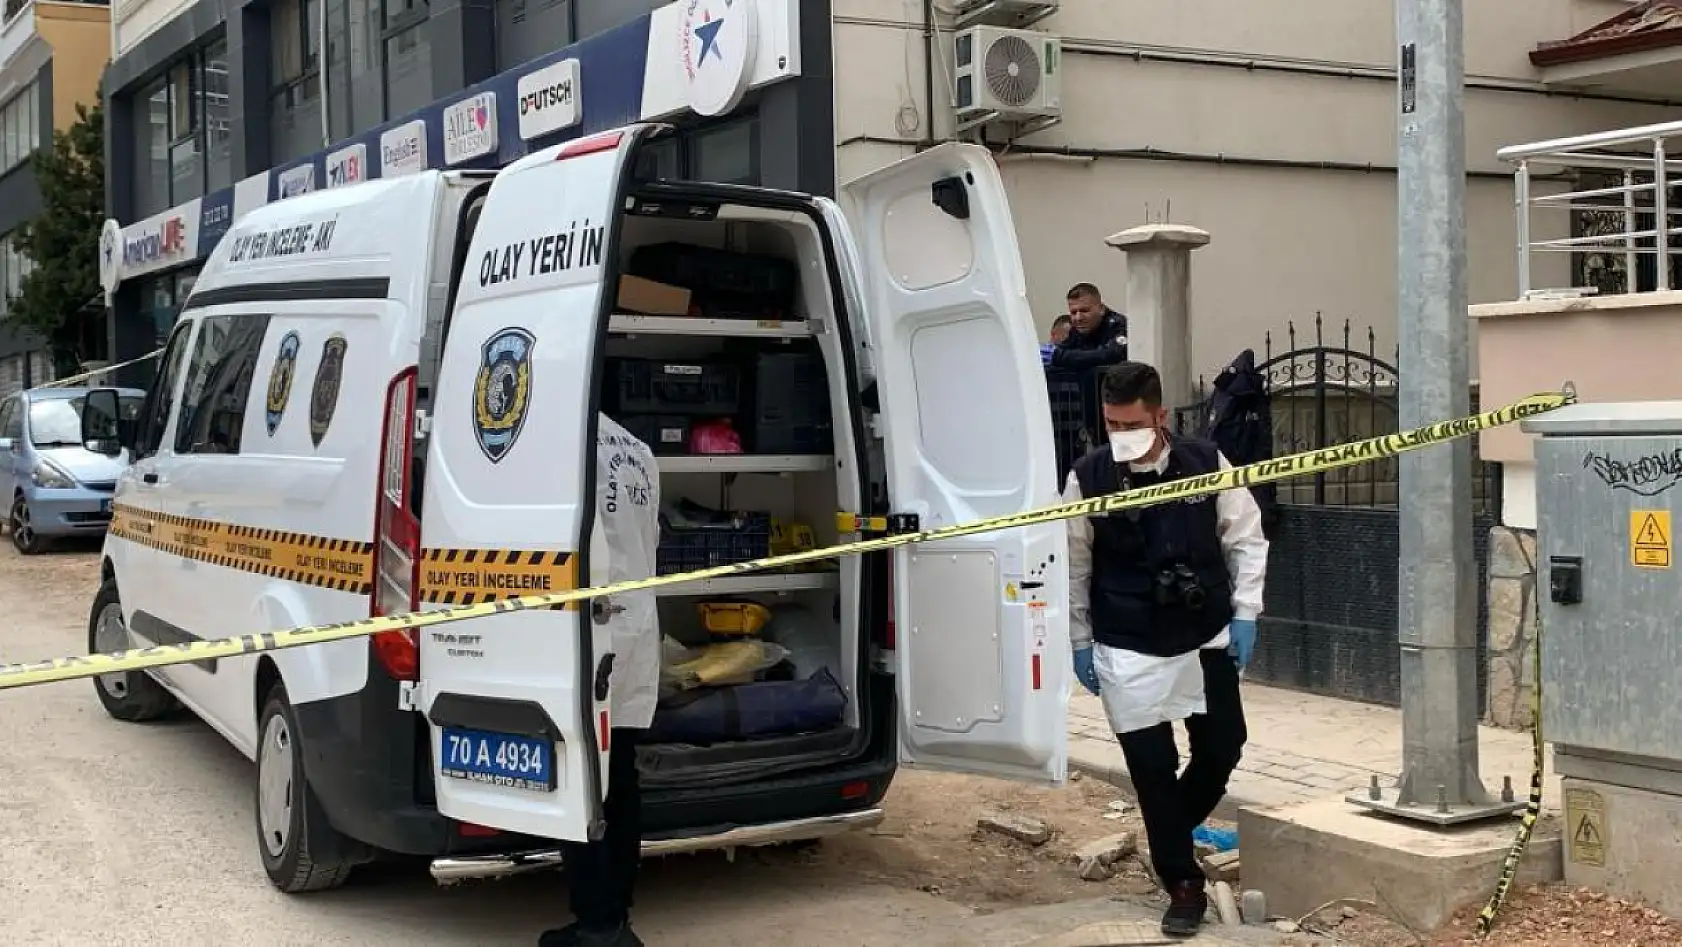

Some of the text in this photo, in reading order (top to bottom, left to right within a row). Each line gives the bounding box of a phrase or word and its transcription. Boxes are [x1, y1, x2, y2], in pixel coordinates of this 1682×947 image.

[521, 82, 572, 116] DEUTSCH
[480, 242, 525, 287] OLAY
[529, 221, 576, 276] YERİ
[427, 570, 551, 590] OLAY YERİ İNCELEME
[449, 735, 543, 775] 70 A 4934
